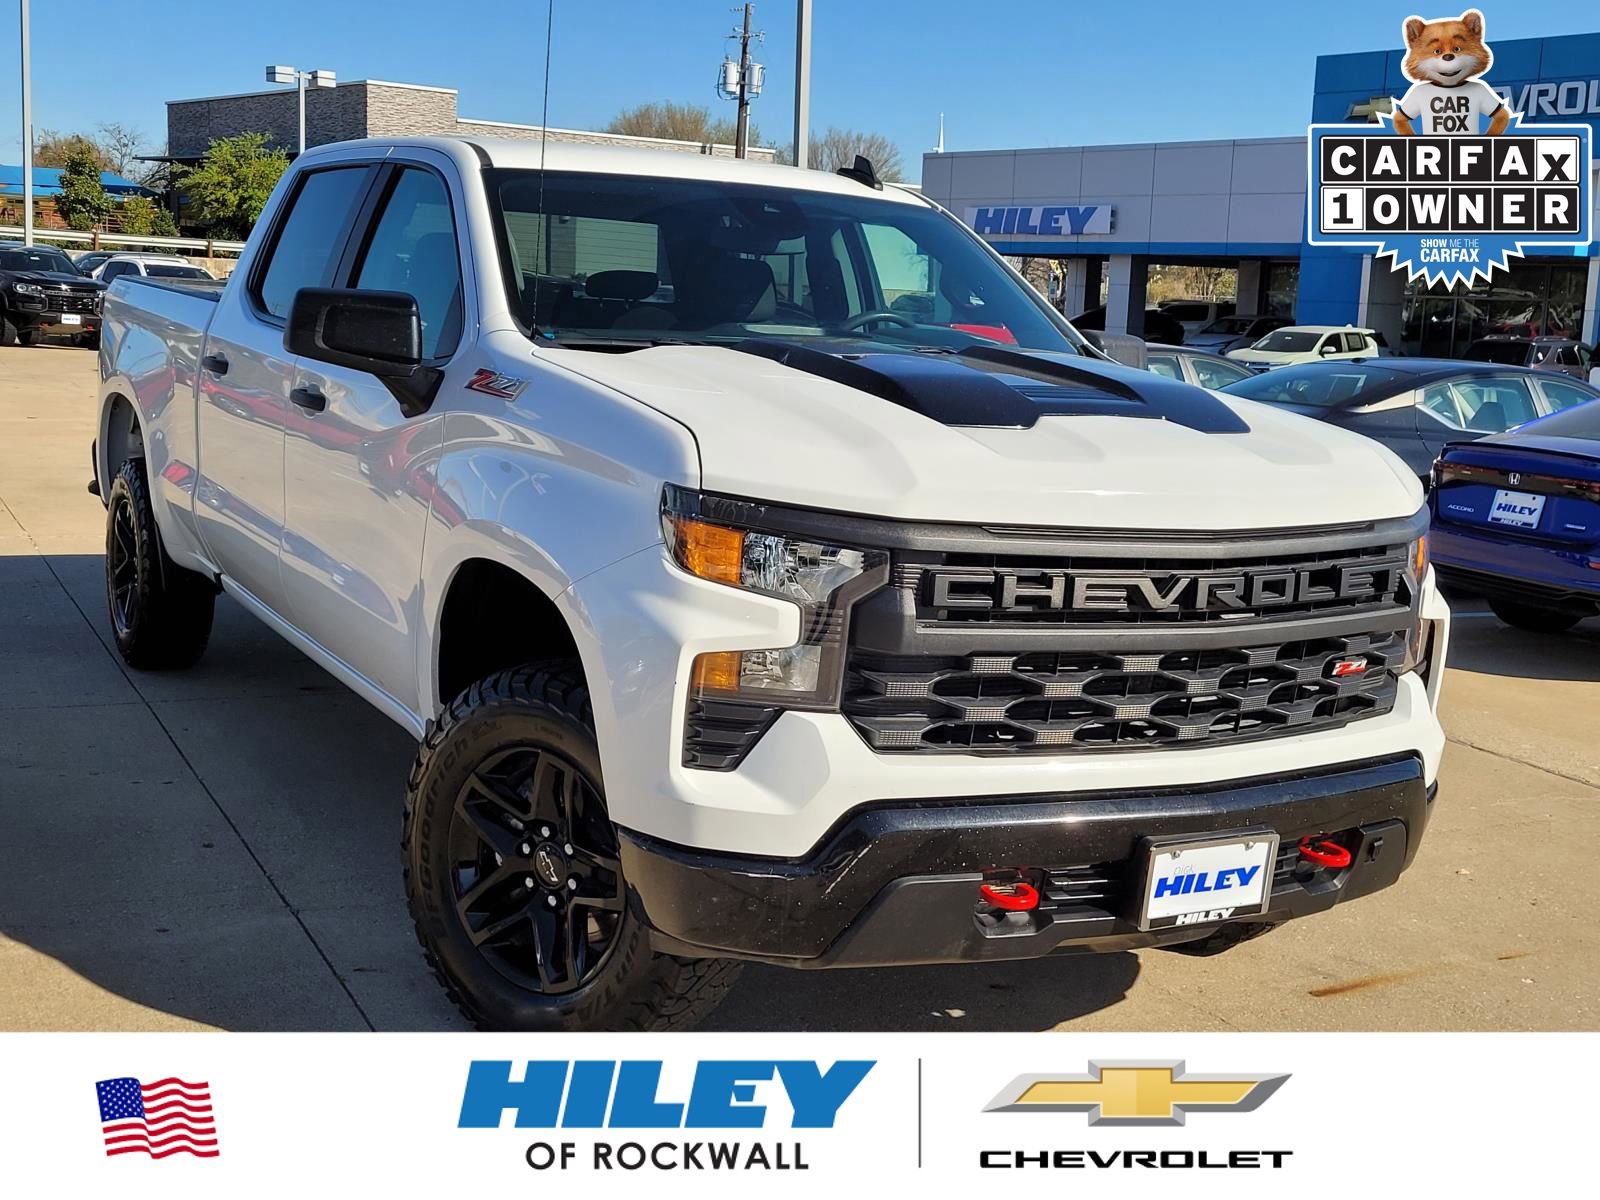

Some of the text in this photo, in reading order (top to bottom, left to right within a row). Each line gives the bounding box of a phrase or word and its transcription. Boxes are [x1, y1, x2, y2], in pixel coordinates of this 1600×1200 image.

[974, 206, 1098, 235] HILEY
[1496, 502, 1537, 516] HILEY
[931, 562, 1402, 609] CHEVROLET
[1154, 865, 1261, 899] HILEY
[1175, 907, 1236, 926] HILEY
